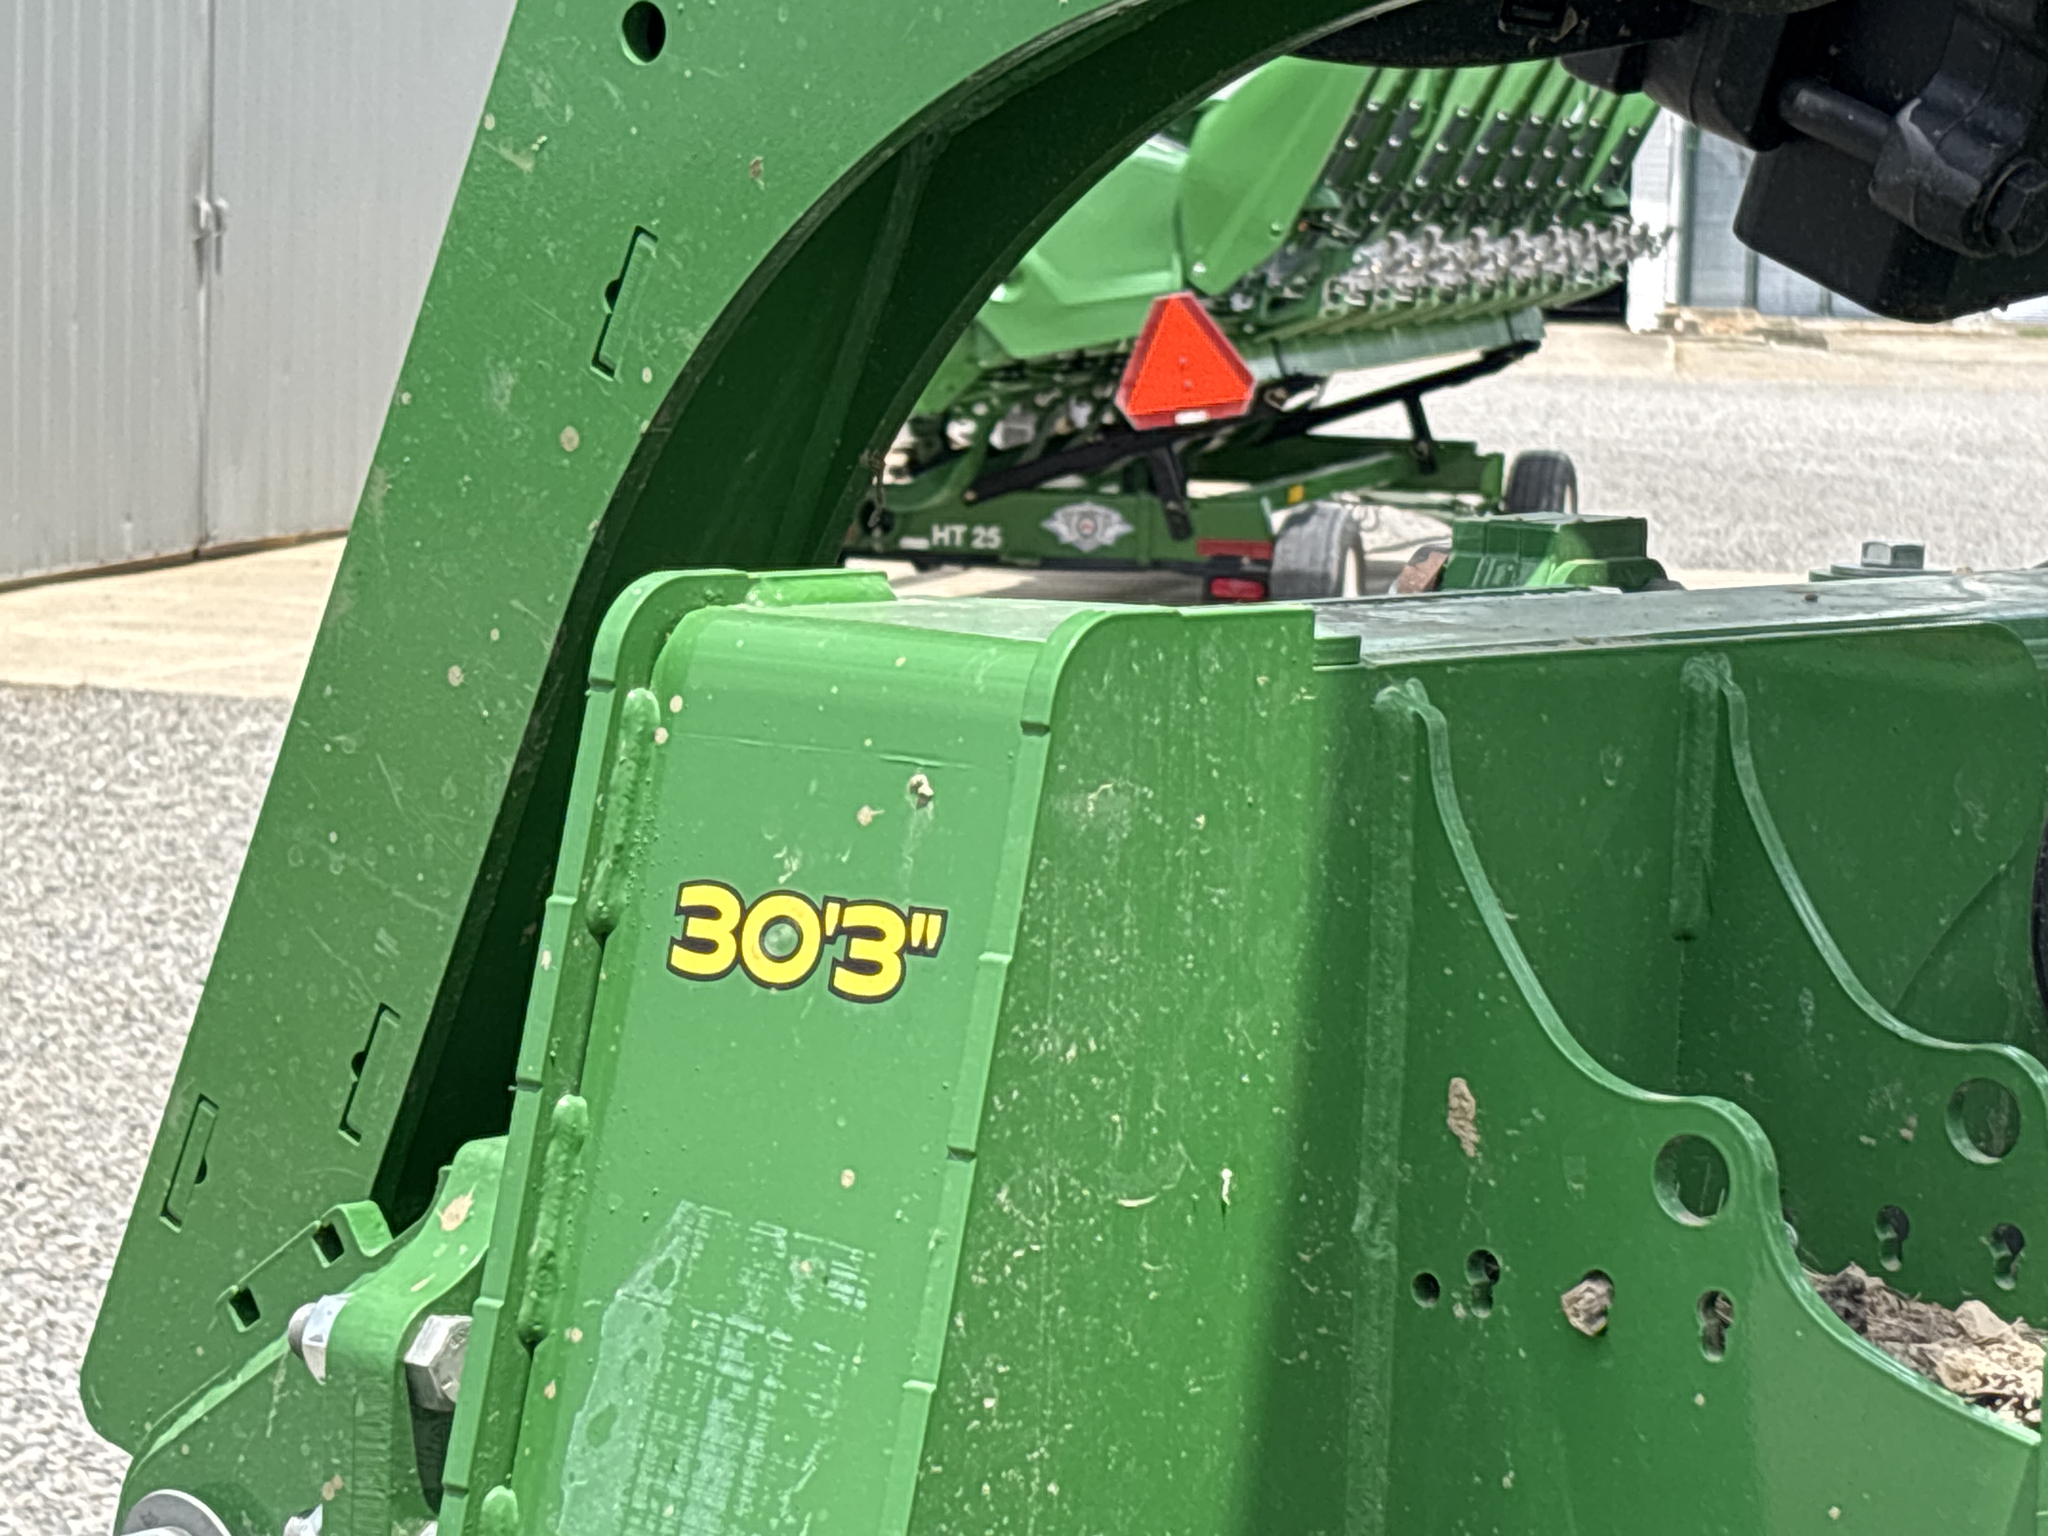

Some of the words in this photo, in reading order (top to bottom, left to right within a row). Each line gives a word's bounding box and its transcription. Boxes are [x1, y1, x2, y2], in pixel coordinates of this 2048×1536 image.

[931, 524, 967, 547] HT
[971, 525, 1002, 549] 25
[667, 880, 948, 1003] 30'3"
